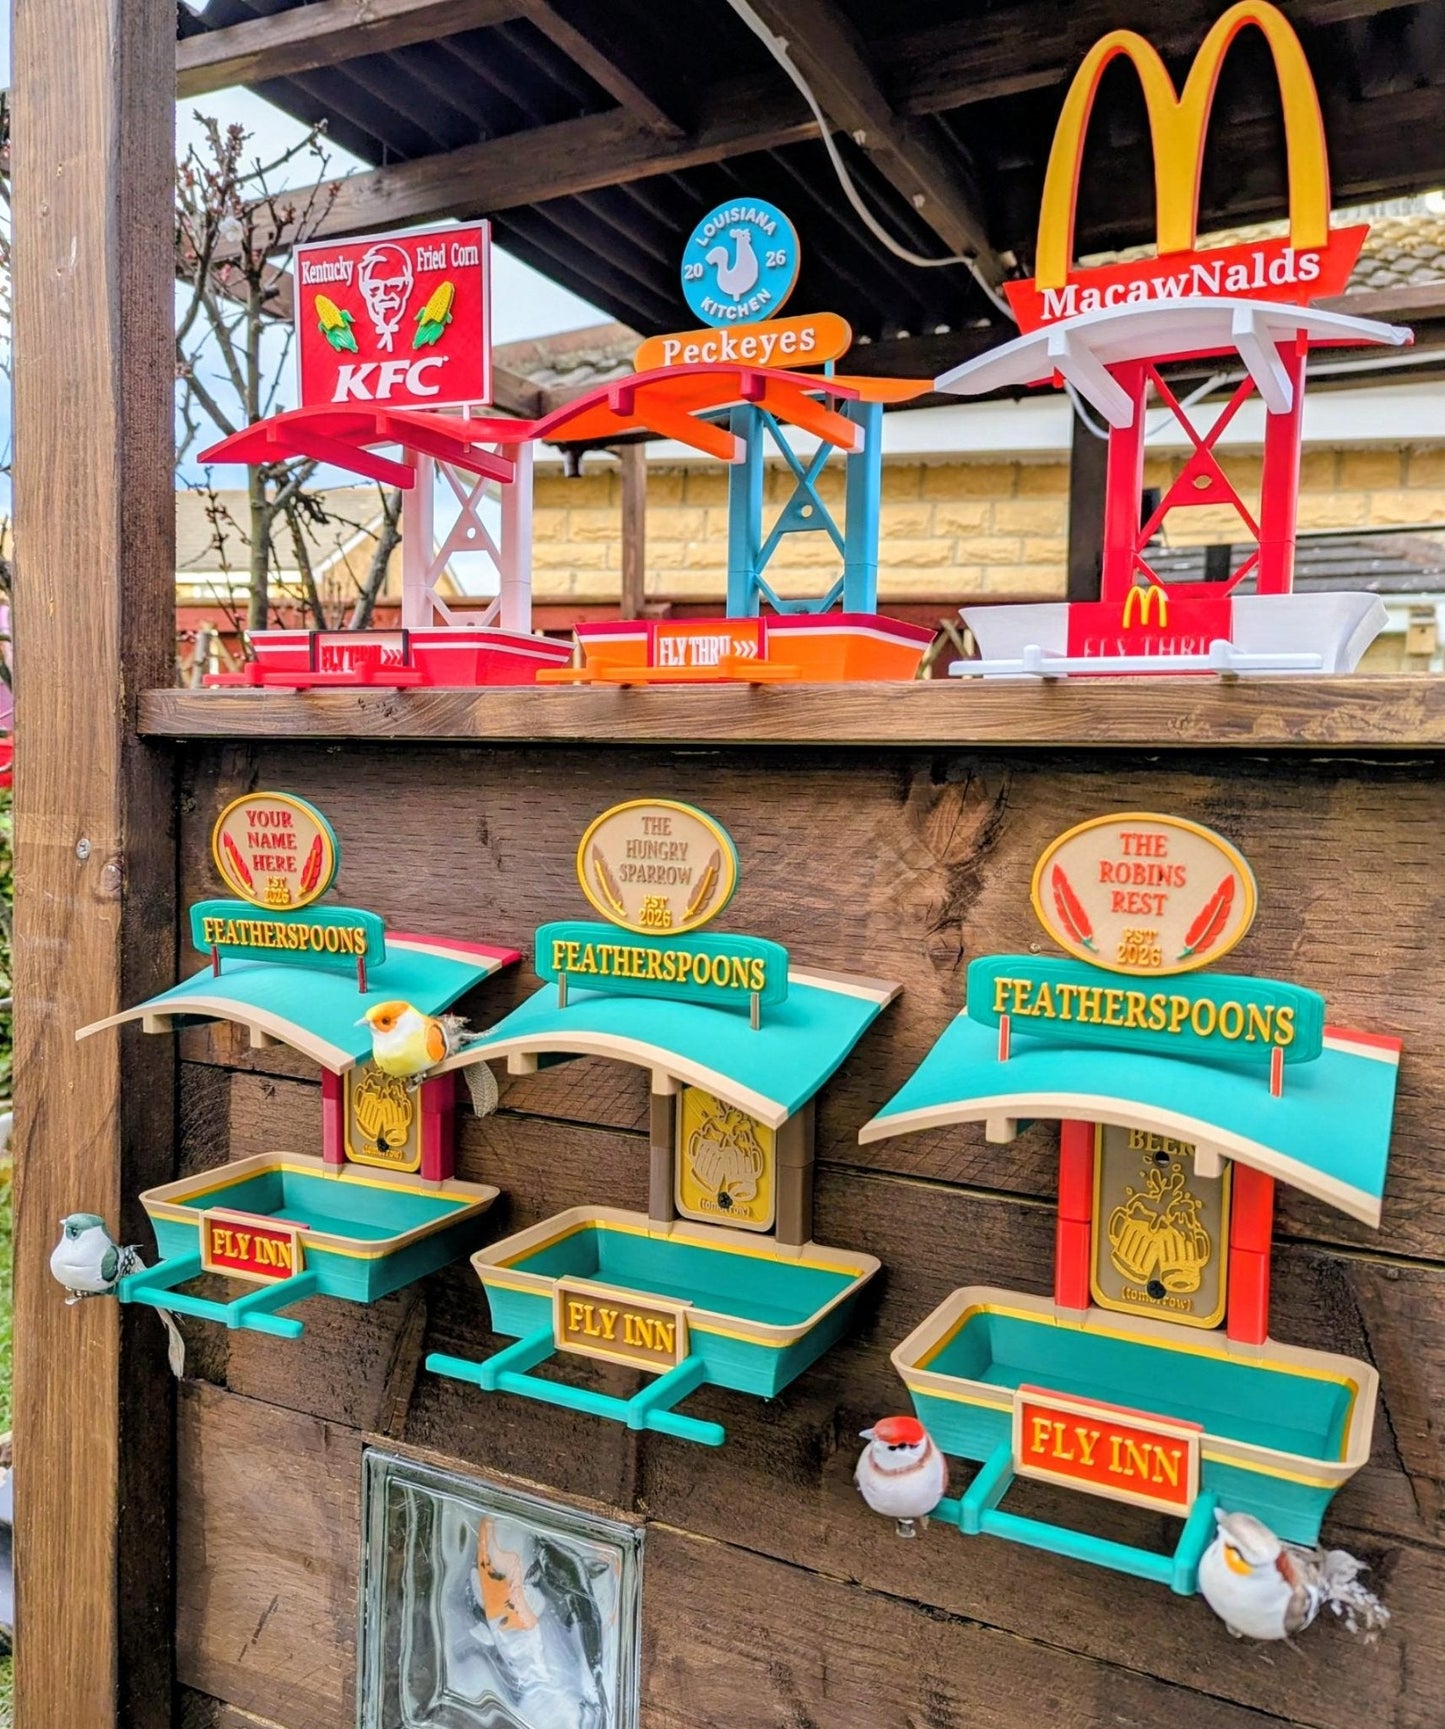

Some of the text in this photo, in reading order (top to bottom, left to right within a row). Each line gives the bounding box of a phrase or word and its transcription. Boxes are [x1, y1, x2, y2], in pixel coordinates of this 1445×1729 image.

[696, 207, 777, 247] LOUISIANA
[302, 242, 480, 286] Kentucky Fried Corn
[684, 250, 786, 279] 20 26
[1040, 248, 1321, 320] MacawNalds
[700, 288, 772, 320] KITCHEN
[662, 327, 816, 366] Peckeyes
[331, 356, 449, 403] KFC
[659, 634, 732, 667] FLY THRU
[245, 810, 294, 829] YOUR
[641, 816, 672, 836] THE
[247, 832, 297, 851] NAME
[626, 839, 688, 862] HUNGRY
[1119, 832, 1167, 857] THE
[252, 854, 297, 873] HERE
[619, 863, 693, 886] SPARROW
[1099, 860, 1186, 888] ROBINS
[643, 895, 668, 909] EST
[1111, 890, 1168, 917] REST
[638, 909, 672, 928] 2026
[202, 917, 368, 955] FEATHERSPOONS
[1123, 928, 1158, 945] EST
[552, 940, 765, 990] FEATHERSPOONS
[1117, 944, 1162, 968] 2026
[993, 977, 1295, 1046] FEATHERSPOONS
[212, 1228, 292, 1269] FLY INN
[568, 1302, 675, 1353] FLY INN
[1031, 1417, 1182, 1487] FLY INN
